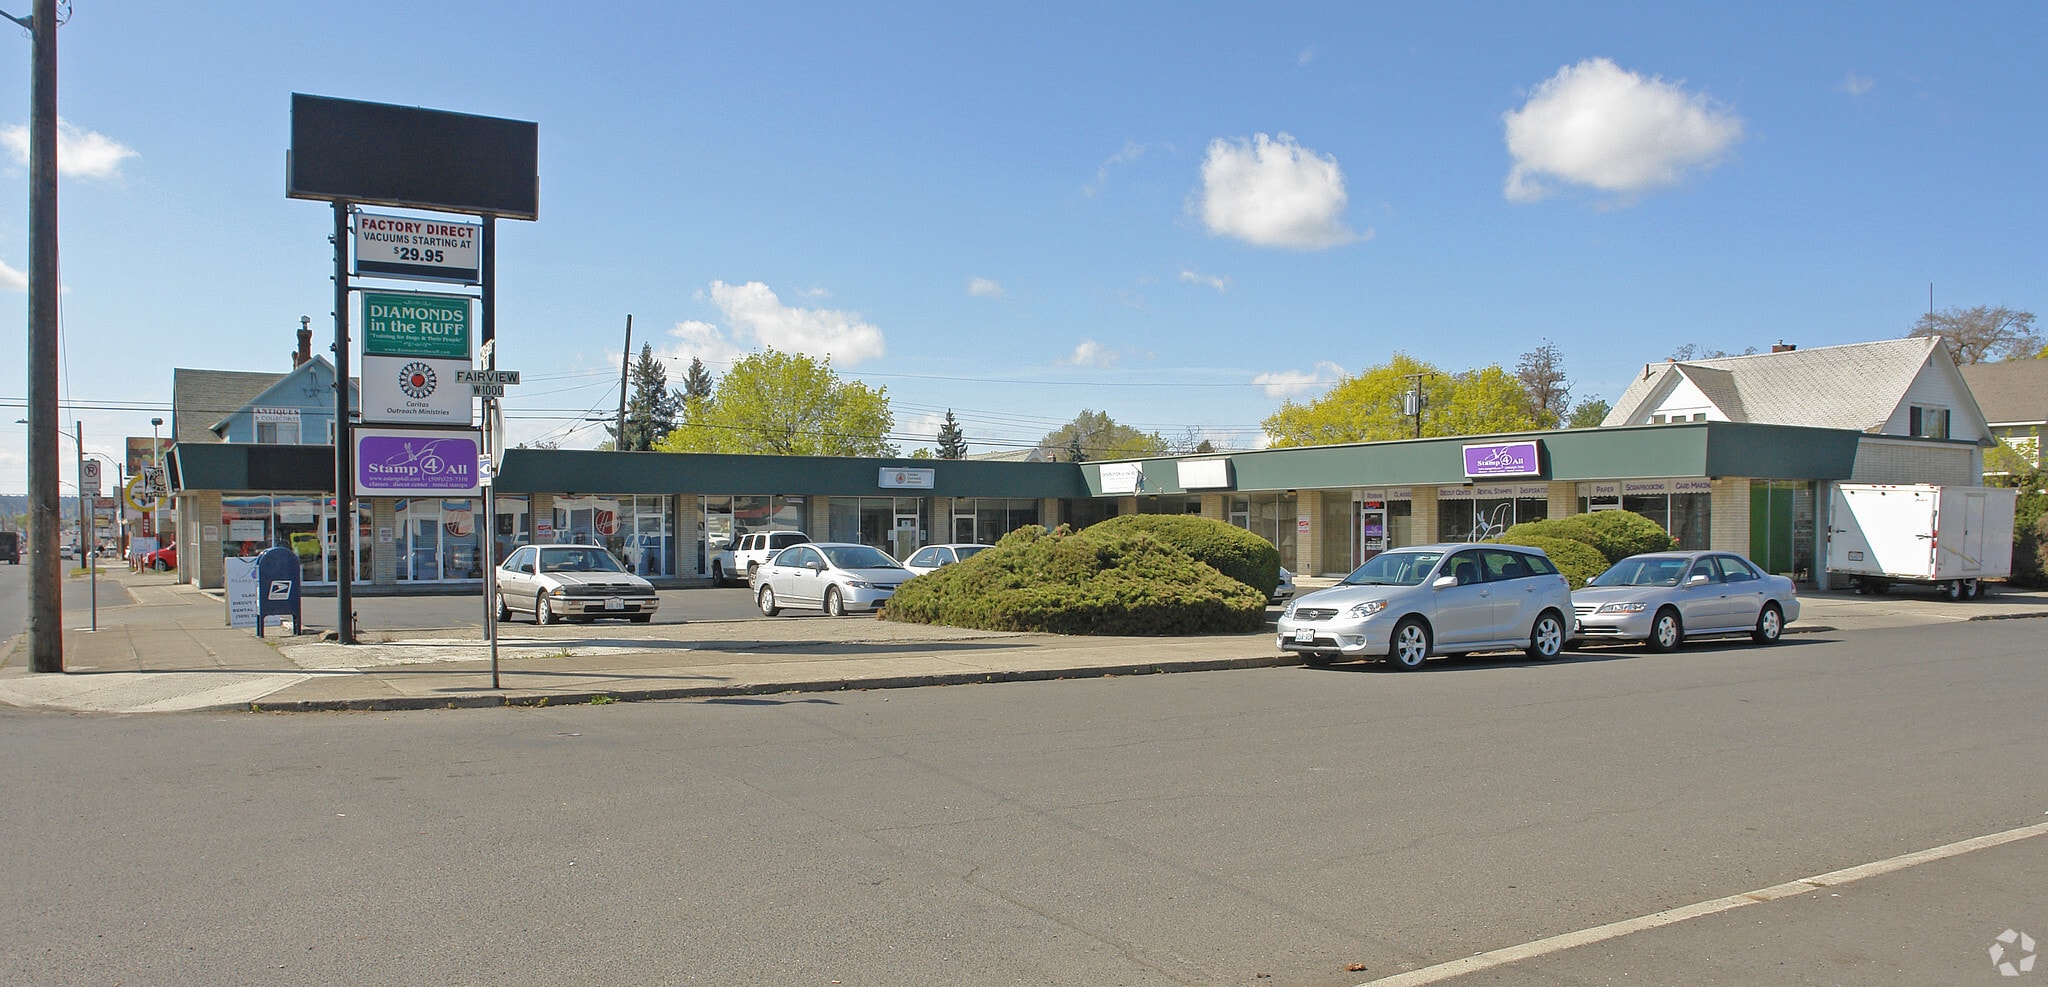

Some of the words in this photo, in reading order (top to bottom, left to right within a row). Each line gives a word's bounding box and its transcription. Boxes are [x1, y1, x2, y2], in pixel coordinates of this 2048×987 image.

[361, 218, 422, 234] FACTORY
[426, 223, 474, 239] DIRECT
[363, 231, 410, 244] VACUUMS
[412, 235, 458, 248] STARTING
[460, 239, 472, 249] AT
[393, 245, 444, 263] $29.95
[370, 304, 464, 322] DIAMONDS
[371, 319, 386, 332] in
[391, 320, 416, 334] the
[421, 321, 465, 336] RUFF
[456, 371, 518, 383] FAIRVIEW
[255, 408, 300, 416] ANTIQUES
[386, 407, 416, 416] Outreach
[417, 408, 450, 416] Ministries
[406, 401, 429, 409] Caritas
[368, 463, 418, 476] Stamp
[423, 457, 438, 472] 4
[445, 464, 468, 475] All
